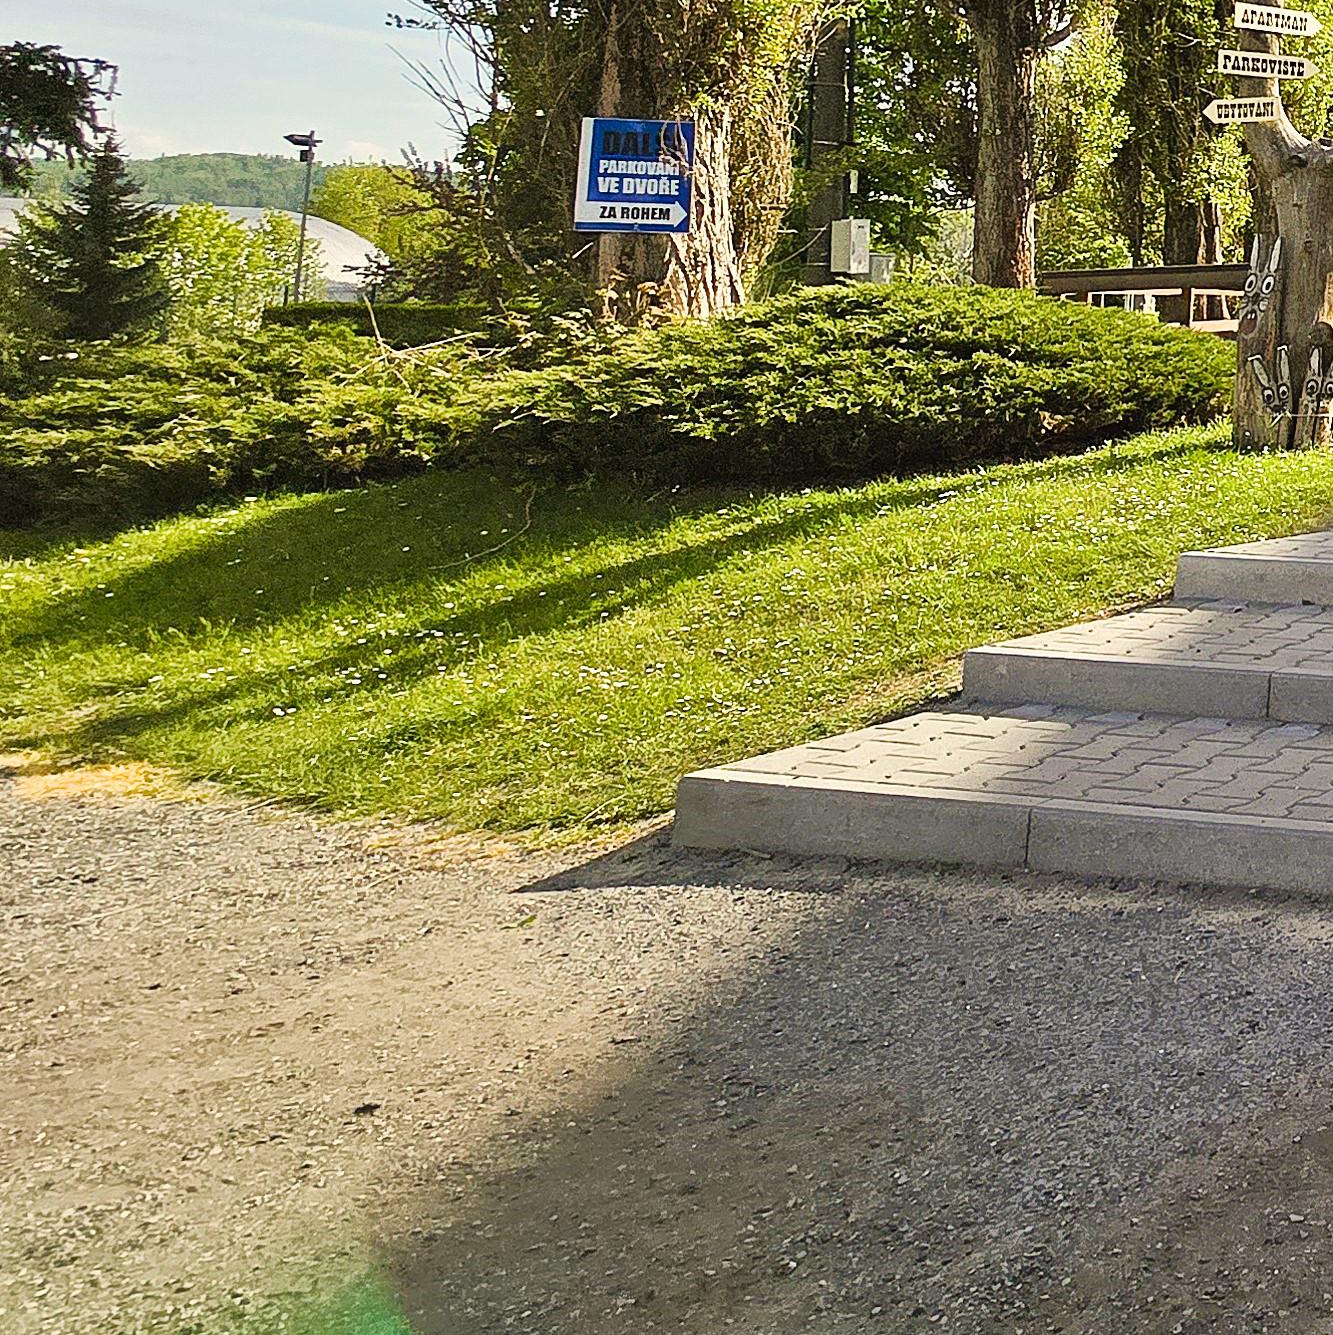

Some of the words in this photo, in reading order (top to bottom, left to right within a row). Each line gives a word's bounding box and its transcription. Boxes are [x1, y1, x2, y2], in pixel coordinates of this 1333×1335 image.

[1241, 8, 1308, 32] APARTMAN
[597, 176, 620, 194] VE
[622, 175, 680, 196] DVOŘE
[599, 205, 617, 219] ZA
[620, 206, 671, 220] ROHEM
